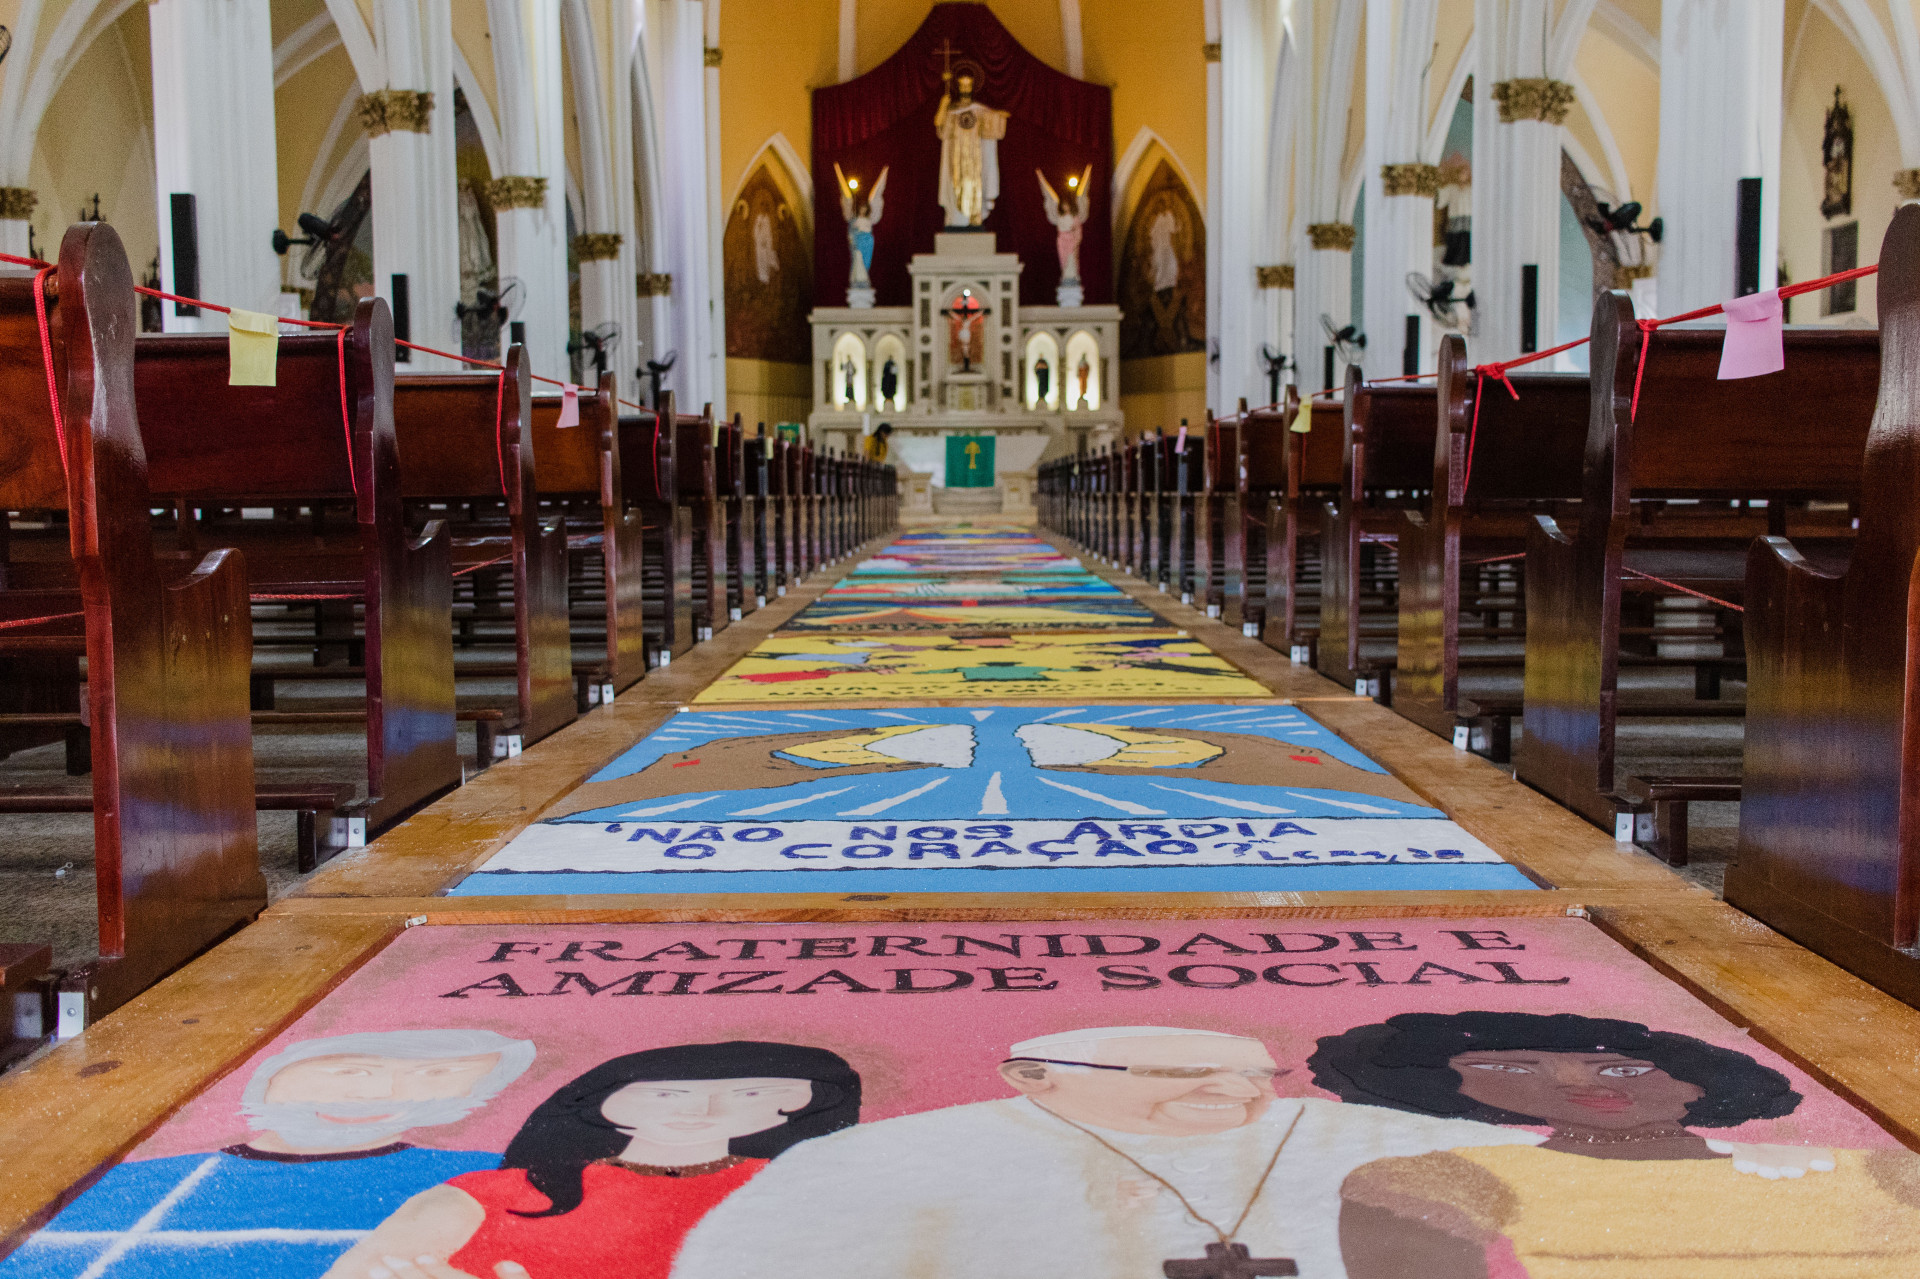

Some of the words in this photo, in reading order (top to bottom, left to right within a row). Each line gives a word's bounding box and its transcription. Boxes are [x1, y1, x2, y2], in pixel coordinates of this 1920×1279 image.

[849, 824, 1013, 842] NOS
[1064, 821, 1317, 841] ARDIA
[664, 843, 717, 859] O
[477, 931, 1419, 963] FRATERNIDADE
[1439, 930, 1527, 951] E
[438, 966, 1058, 998] AMIZADE
[1097, 960, 1571, 990] SOCIAL
